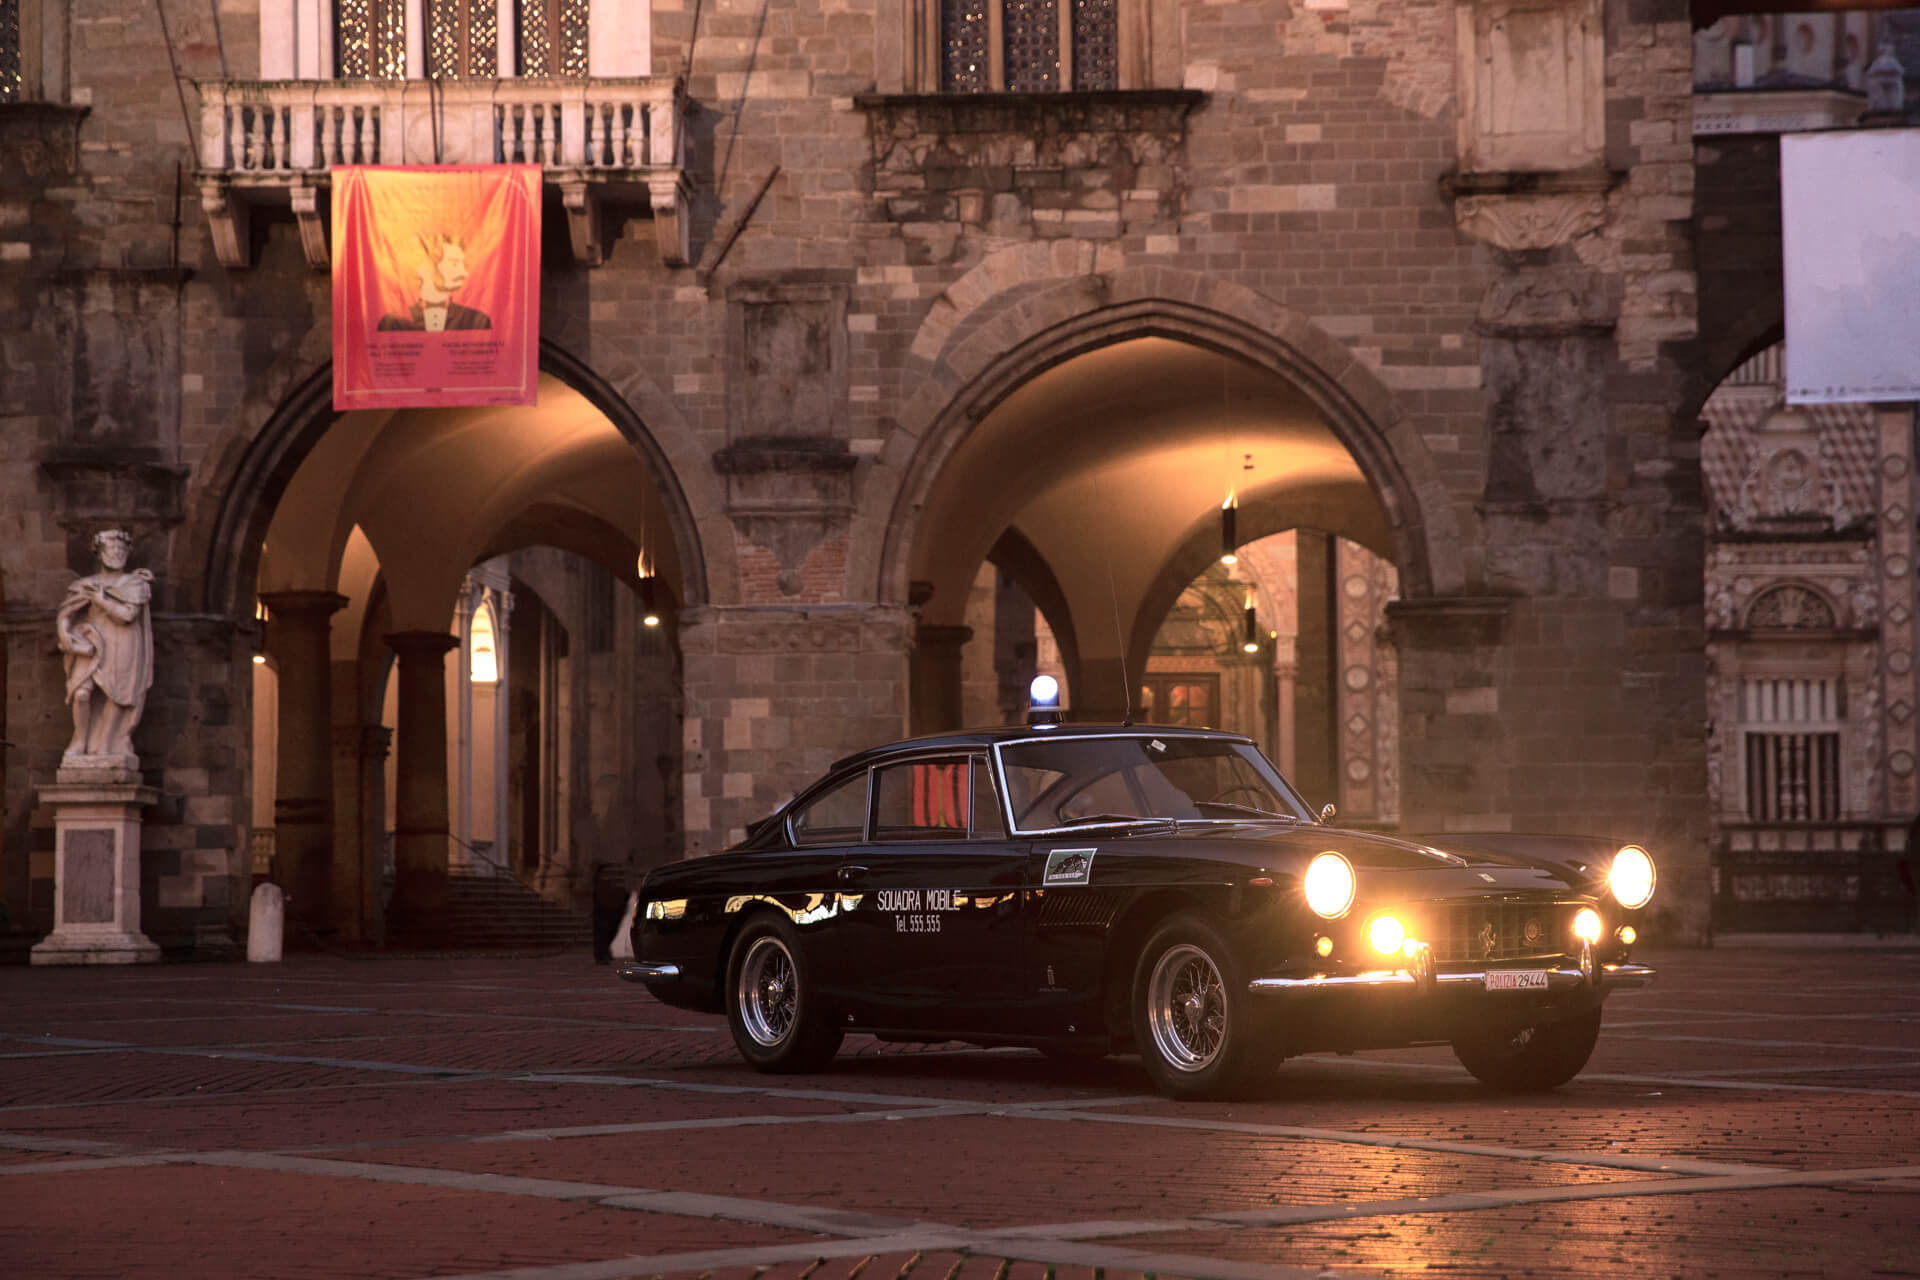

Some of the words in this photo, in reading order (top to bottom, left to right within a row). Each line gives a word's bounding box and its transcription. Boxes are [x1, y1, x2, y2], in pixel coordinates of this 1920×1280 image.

[877, 890, 921, 911] SQUADRA
[926, 889, 961, 911] MOBILE
[895, 915, 908, 933] Tel.
[910, 914, 941, 933] 555.555
[1490, 974, 1517, 988] POLIZIA
[1518, 973, 1545, 987] 29444
